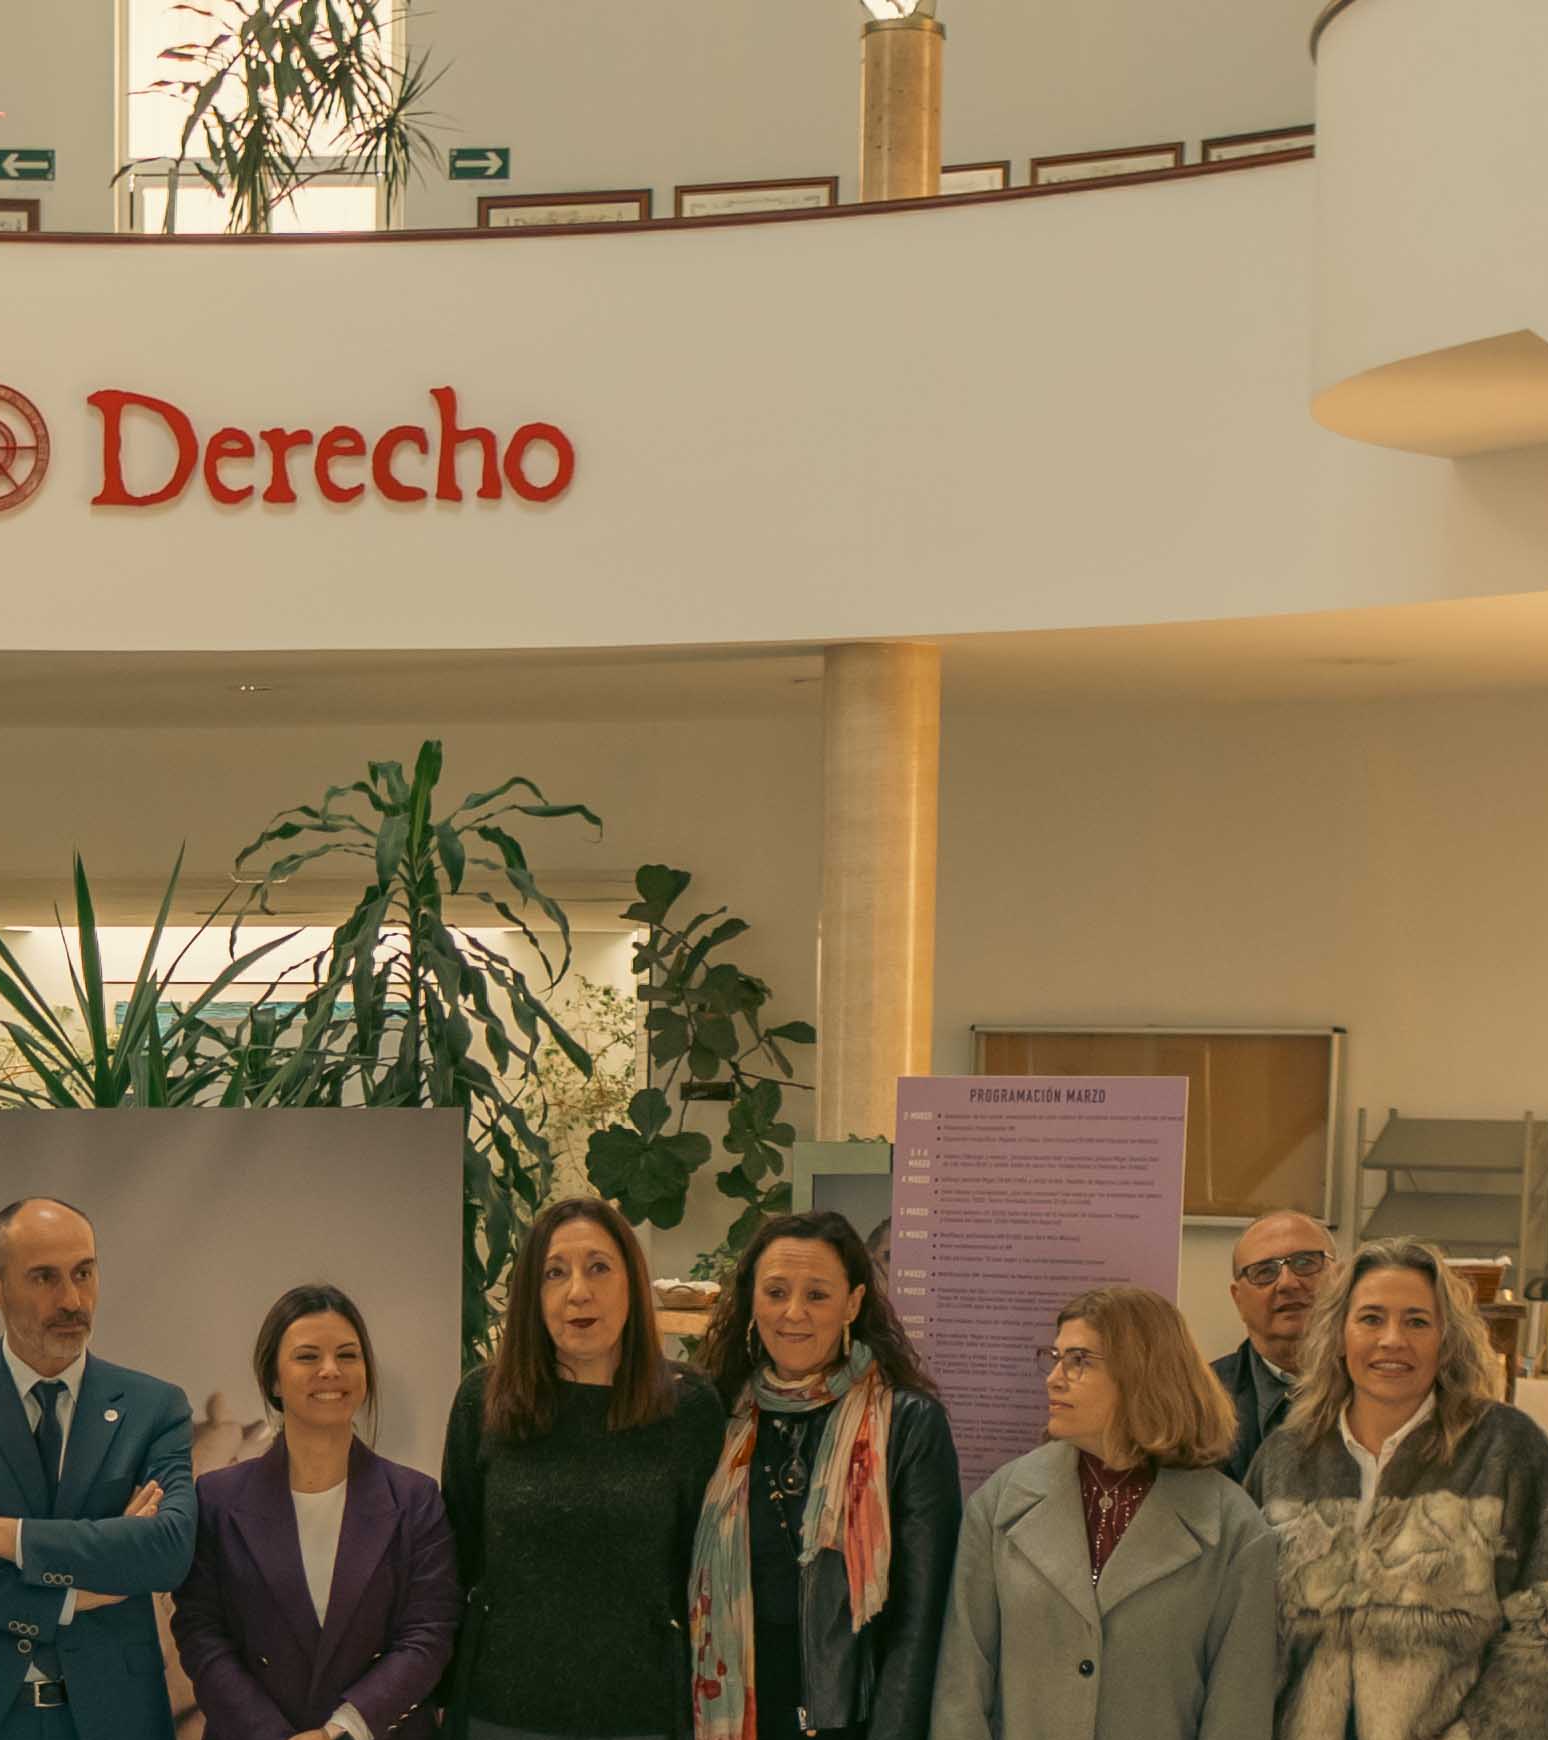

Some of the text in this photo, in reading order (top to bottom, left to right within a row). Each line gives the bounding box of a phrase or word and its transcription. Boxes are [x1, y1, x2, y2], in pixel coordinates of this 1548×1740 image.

[86, 385, 575, 506] Derecho
[970, 1087, 1106, 1104] PROGRAMACIÓN MARZO
